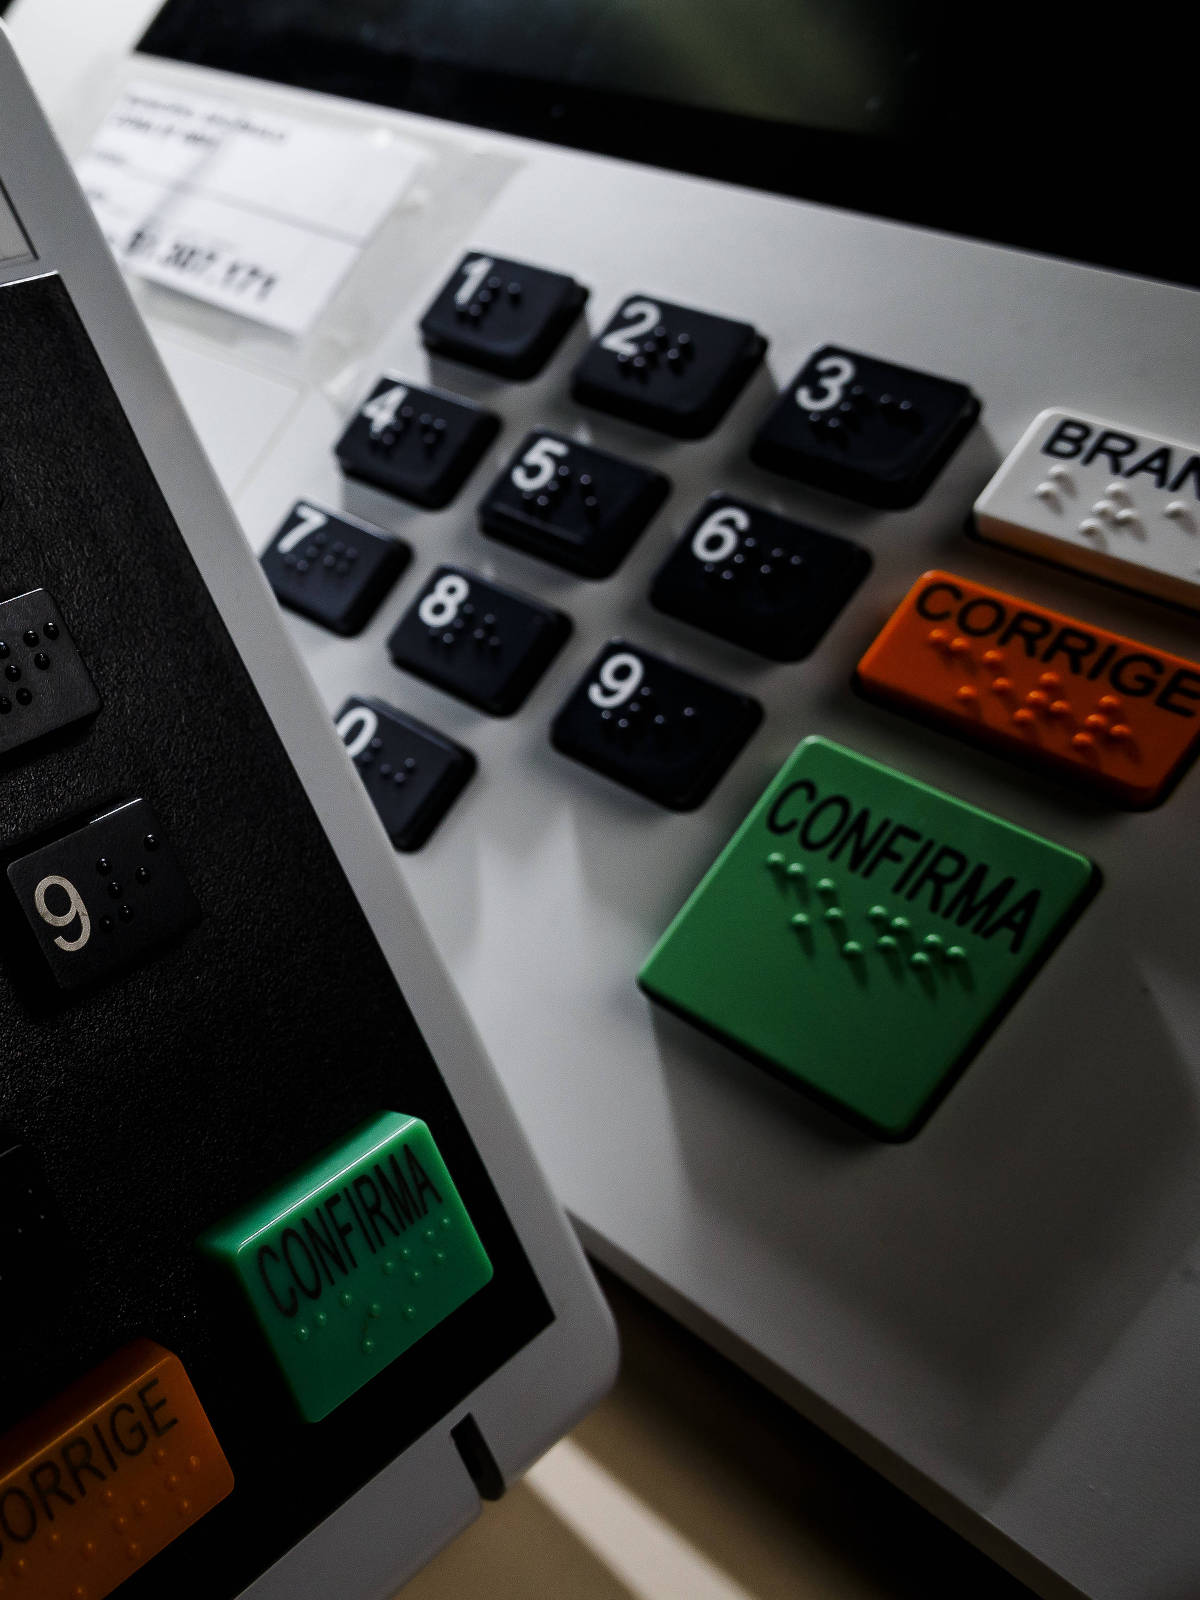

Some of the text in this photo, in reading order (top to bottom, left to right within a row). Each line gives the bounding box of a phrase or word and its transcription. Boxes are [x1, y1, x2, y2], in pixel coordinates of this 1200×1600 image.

[455, 256, 494, 306] 1
[600, 300, 661, 357] 2
[360, 381, 404, 439] 4
[794, 354, 856, 412] 3
[510, 436, 569, 492] 5
[277, 508, 328, 554] 7
[691, 506, 751, 563] 6
[417, 573, 470, 629] 8
[915, 582, 1200, 718] CORRIGE
[587, 652, 644, 709] 9
[766, 780, 1041, 953] CONFIRMA
[33, 873, 92, 953] 9
[257, 1143, 443, 1319] CONFIRMA
